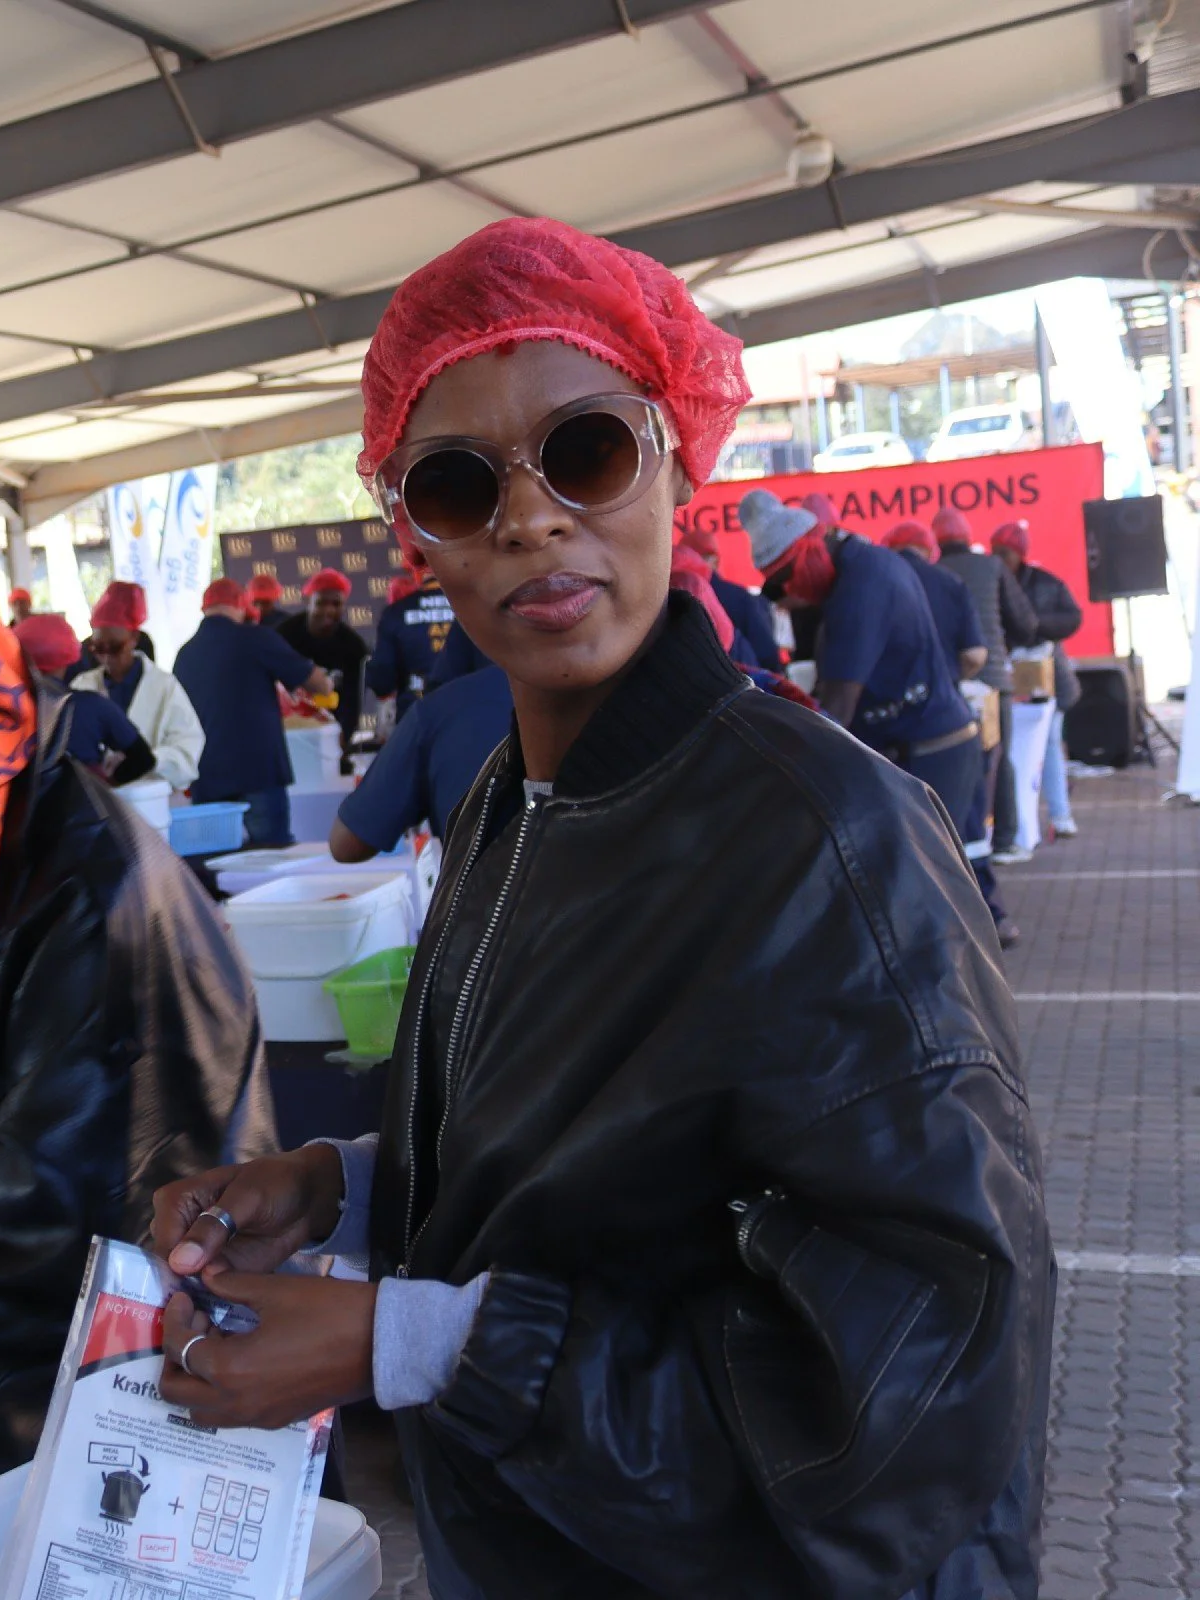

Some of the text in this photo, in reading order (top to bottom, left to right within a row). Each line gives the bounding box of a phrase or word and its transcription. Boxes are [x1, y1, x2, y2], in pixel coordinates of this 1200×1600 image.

[783, 473, 1040, 520] AMPIONS
[403, 609, 455, 624] ENER
[105, 1301, 131, 1316] NOT
[132, 1308, 155, 1321] FOR
